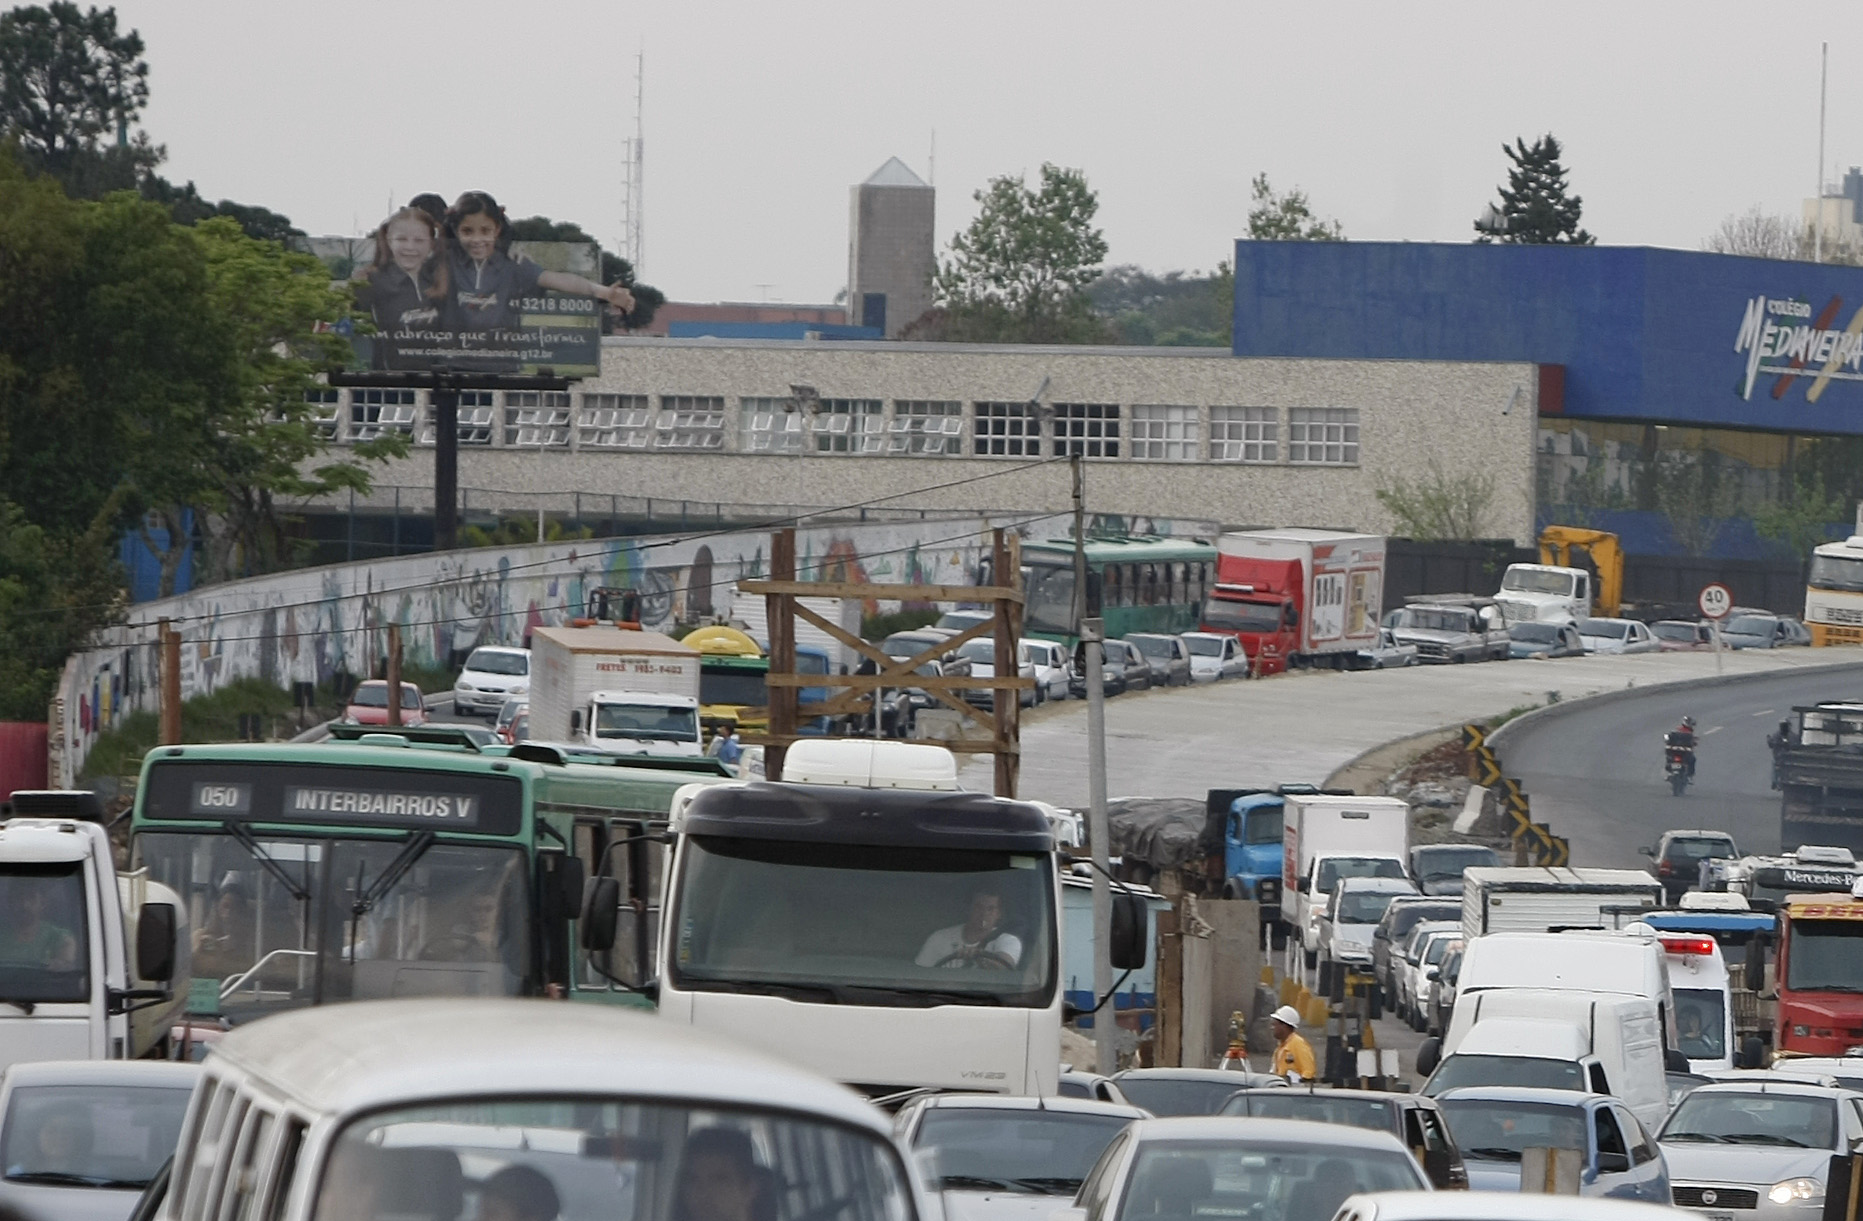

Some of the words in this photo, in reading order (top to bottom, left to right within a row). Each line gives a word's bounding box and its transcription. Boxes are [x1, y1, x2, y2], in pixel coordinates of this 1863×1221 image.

[522, 298, 555, 311] 3218
[559, 299, 594, 312] 8000
[394, 324, 453, 343] abraço
[458, 331, 486, 349] que
[489, 327, 586, 347] Transforma
[1705, 591, 1723, 603] 40
[201, 786, 239, 808] 050
[295, 788, 450, 818] INTERBAIRROS
[456, 797, 471, 818] V
[1784, 871, 1854, 886] Mercedes-B
